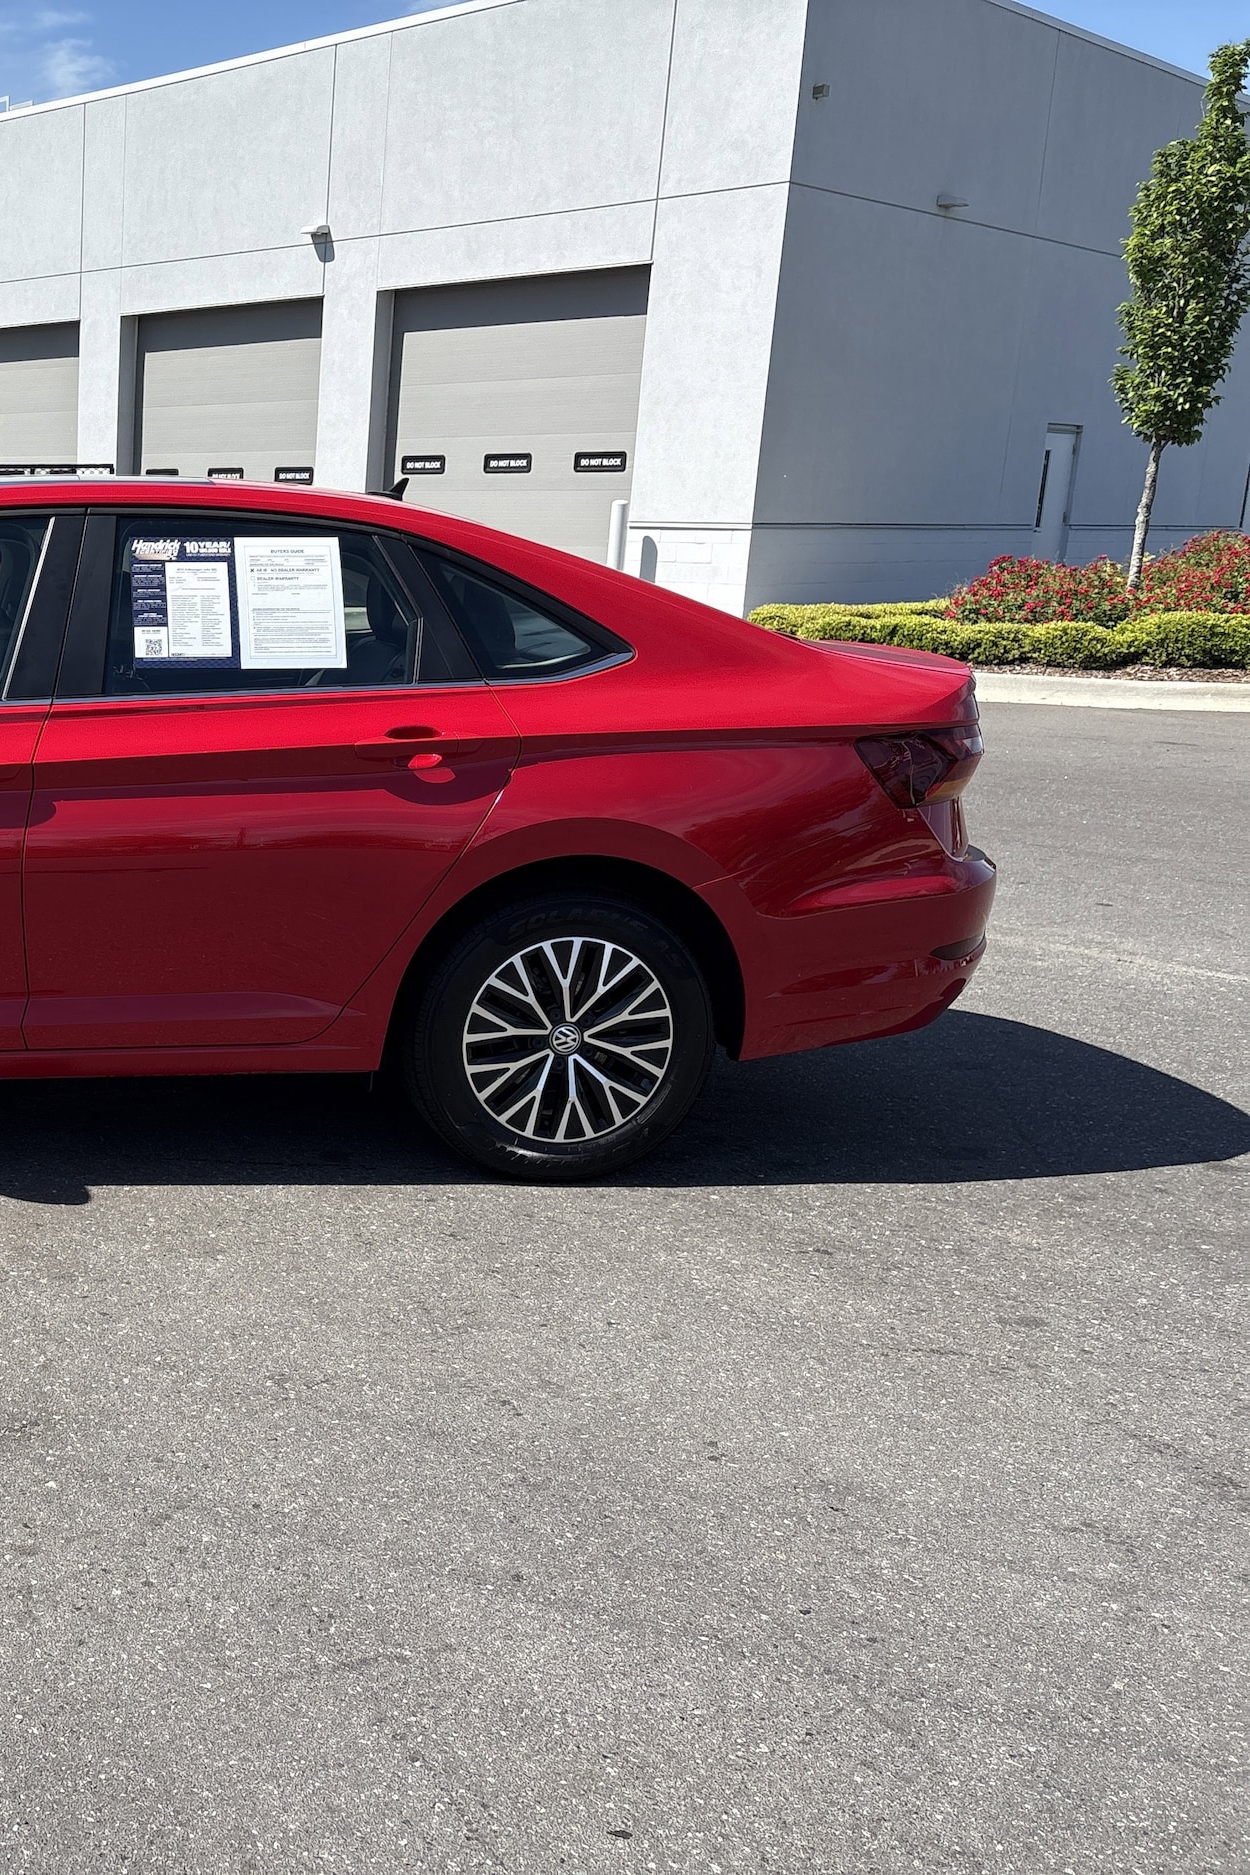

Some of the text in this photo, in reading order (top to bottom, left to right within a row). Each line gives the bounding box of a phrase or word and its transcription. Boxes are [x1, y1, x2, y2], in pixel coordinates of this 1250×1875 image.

[406, 461, 441, 469] DO NOT BLOCK
[489, 459, 528, 468] DO NOT BLOCK
[580, 457, 622, 467] DO NOT BLOCK
[131, 539, 181, 555] Hendrick
[183, 541, 231, 554] 10 YEAR/
